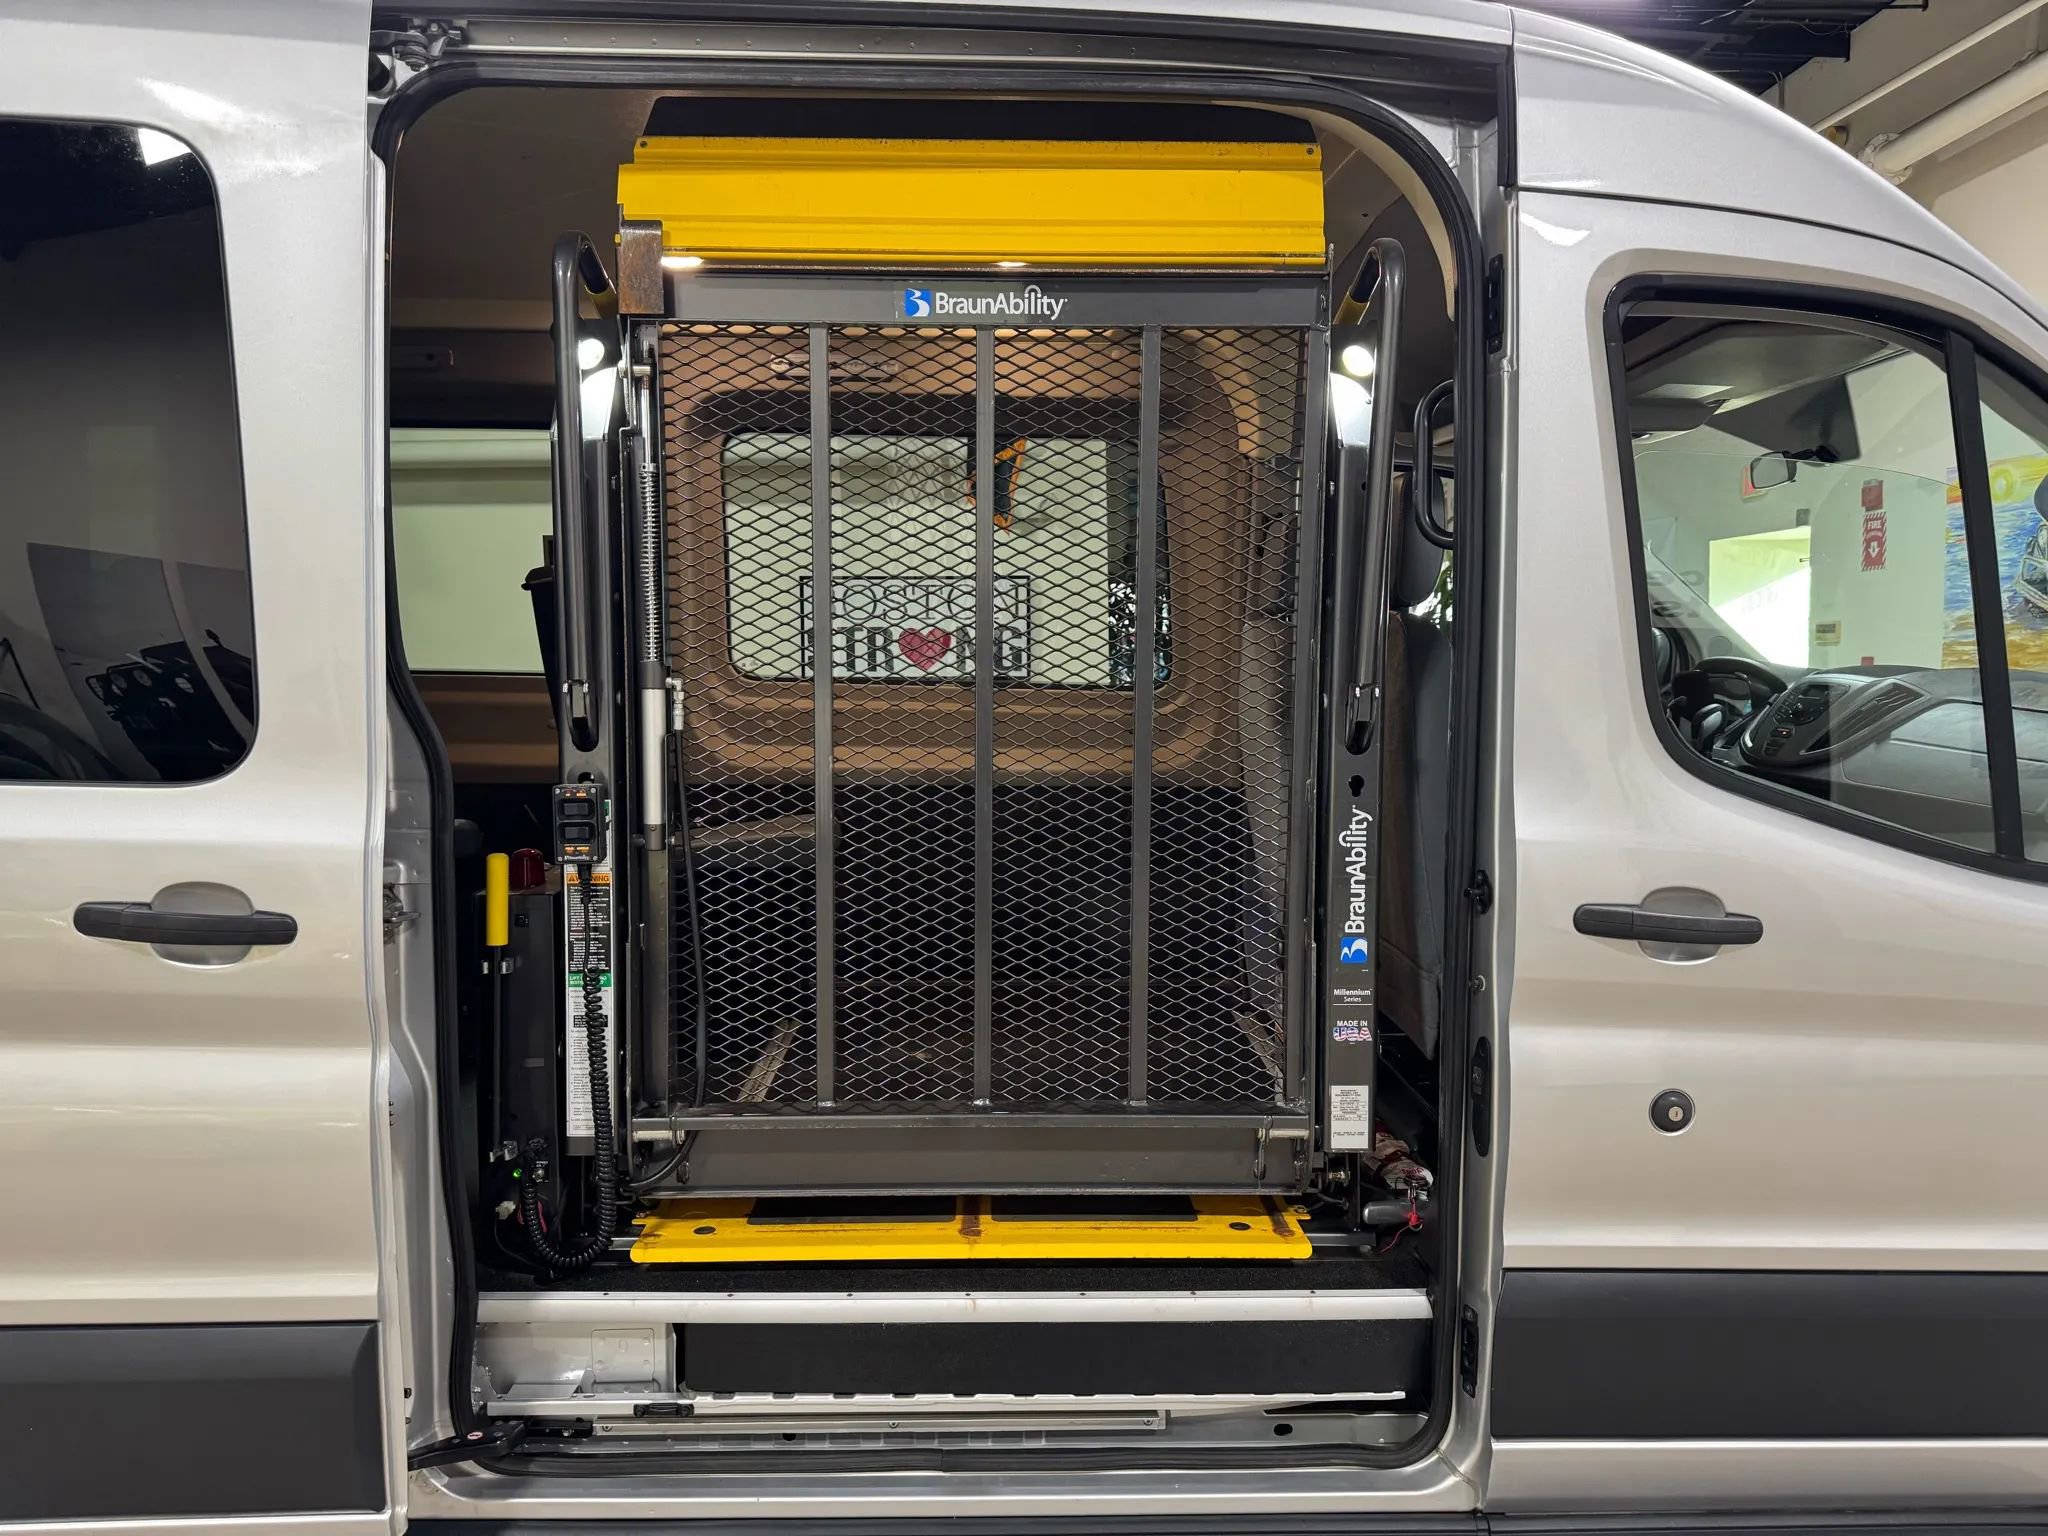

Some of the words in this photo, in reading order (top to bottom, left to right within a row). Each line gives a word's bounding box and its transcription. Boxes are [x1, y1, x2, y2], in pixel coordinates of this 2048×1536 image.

[935, 285, 1064, 321] BraunAbility
[1867, 519, 1882, 530] FIRE
[811, 583, 1023, 621] OSTON
[1338, 807, 1373, 934] BraunAbility
[1333, 988, 1371, 996] Millennium
[1332, 1026, 1373, 1042] USA
